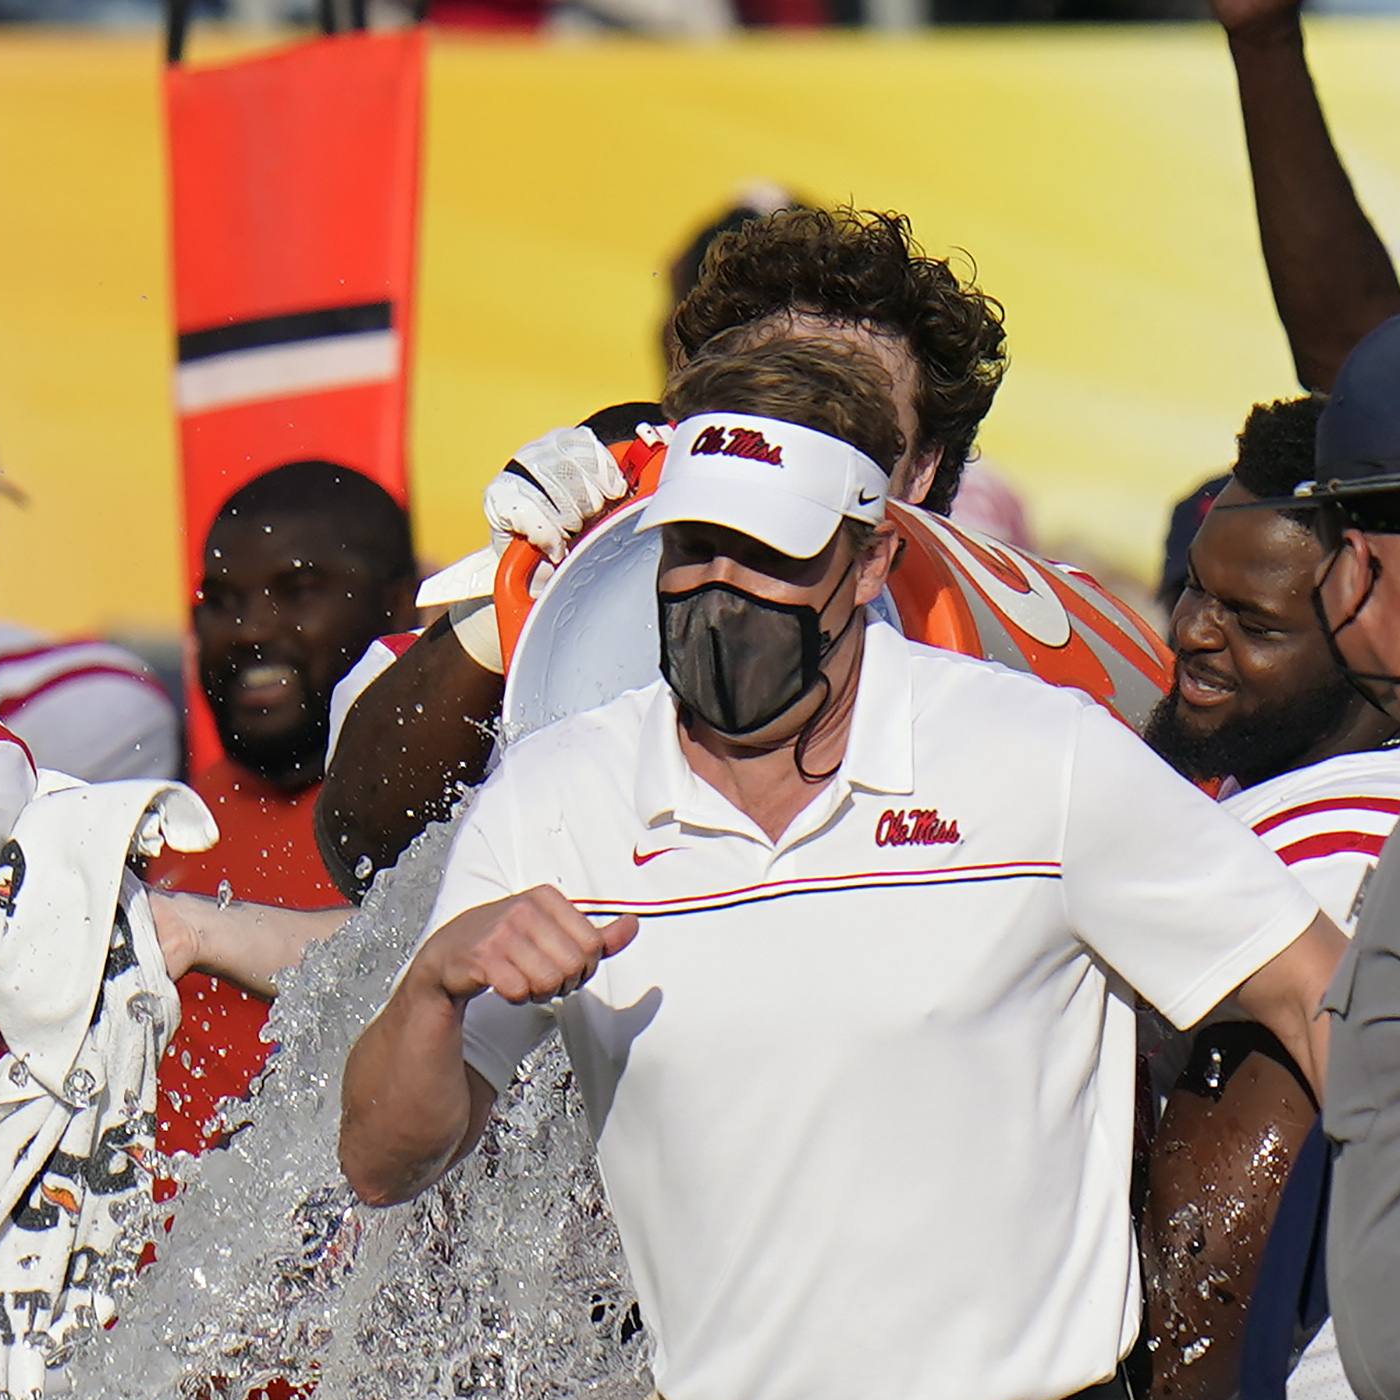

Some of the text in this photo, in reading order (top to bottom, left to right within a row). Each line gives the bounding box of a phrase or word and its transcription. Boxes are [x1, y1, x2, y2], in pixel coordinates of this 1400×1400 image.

[691, 426, 783, 466] Ole Miss
[875, 808, 961, 847] Ole Miss
